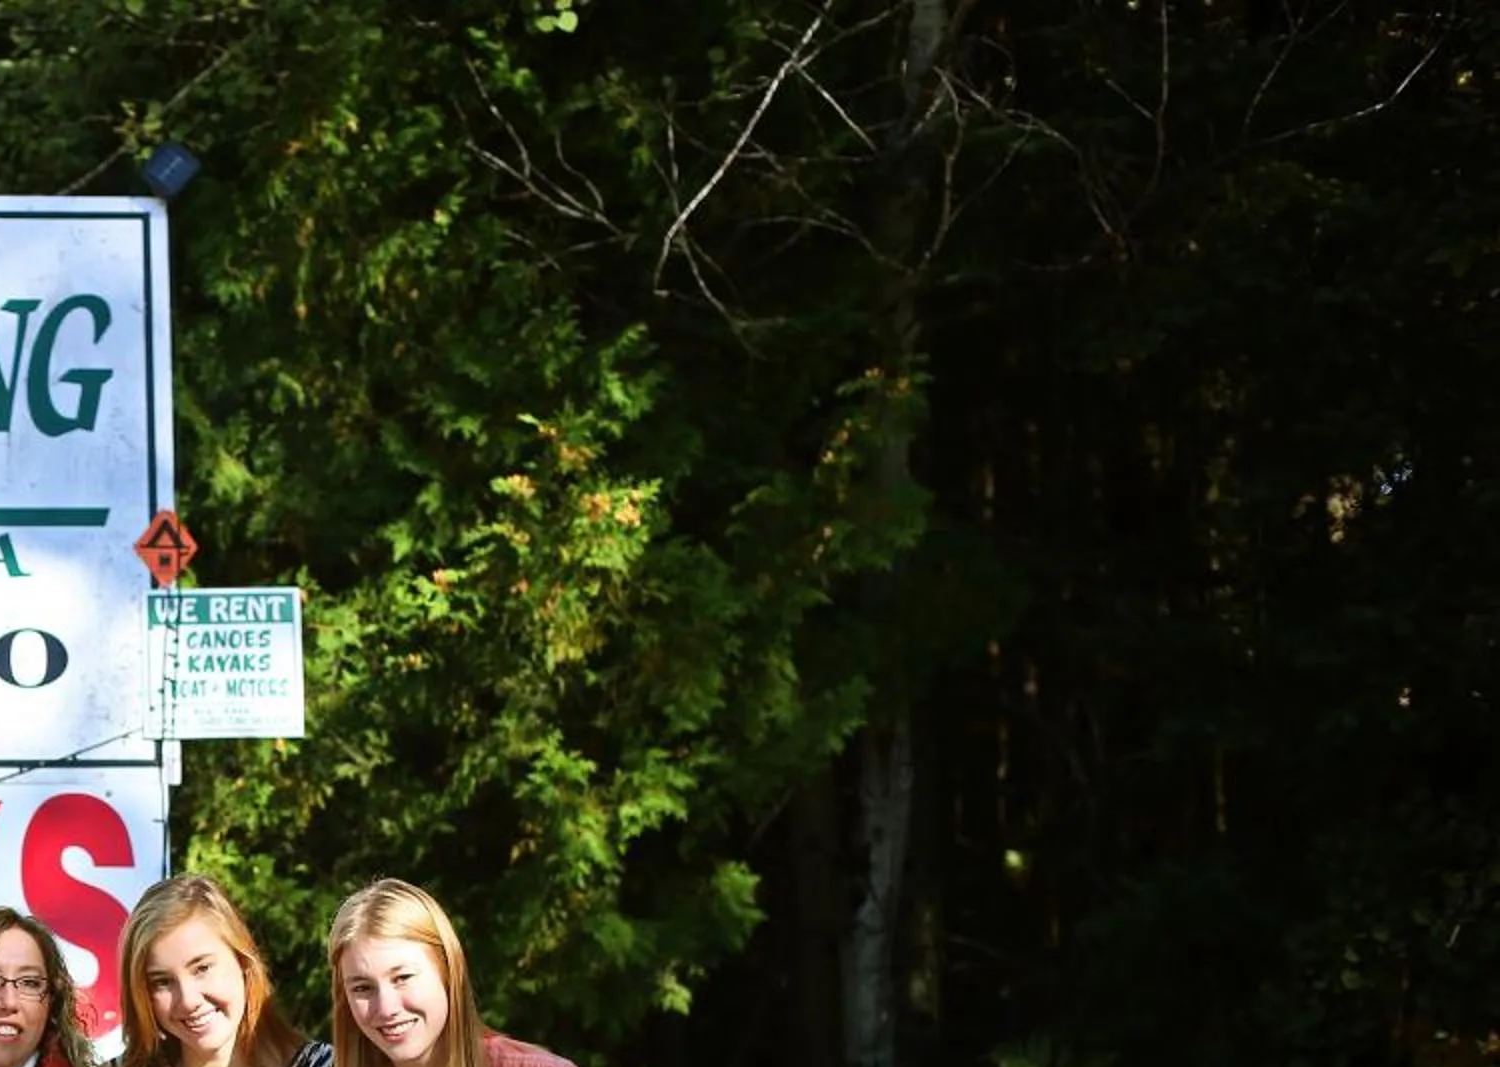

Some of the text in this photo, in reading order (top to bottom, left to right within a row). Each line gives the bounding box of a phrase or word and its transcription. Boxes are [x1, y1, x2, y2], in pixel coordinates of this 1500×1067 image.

[154, 595, 286, 622] WE RENT
[186, 629, 271, 649] CANOES
[188, 653, 271, 673] KAYAKS
